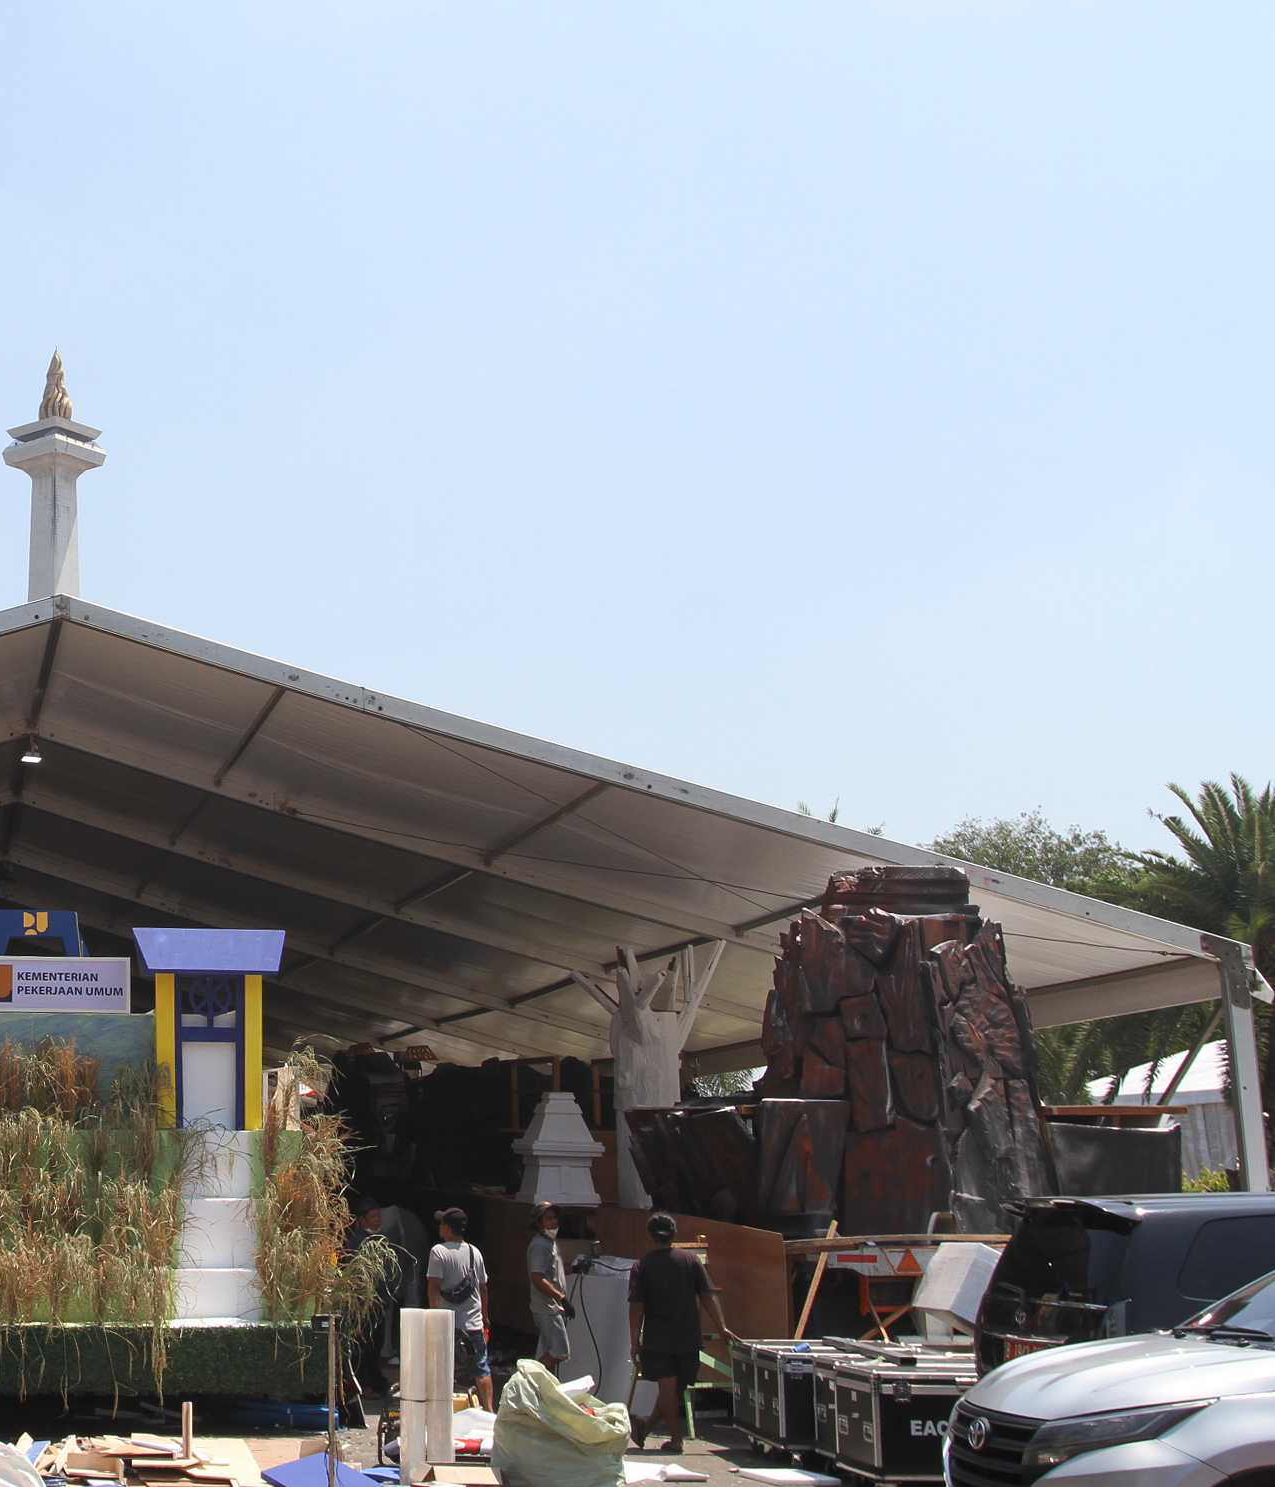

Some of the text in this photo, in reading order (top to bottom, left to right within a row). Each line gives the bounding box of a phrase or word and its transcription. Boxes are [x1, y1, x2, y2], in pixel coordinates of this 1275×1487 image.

[17, 971, 99, 982] KEMENTERIAN
[17, 985, 124, 997] PEKERJAAN UMUM
